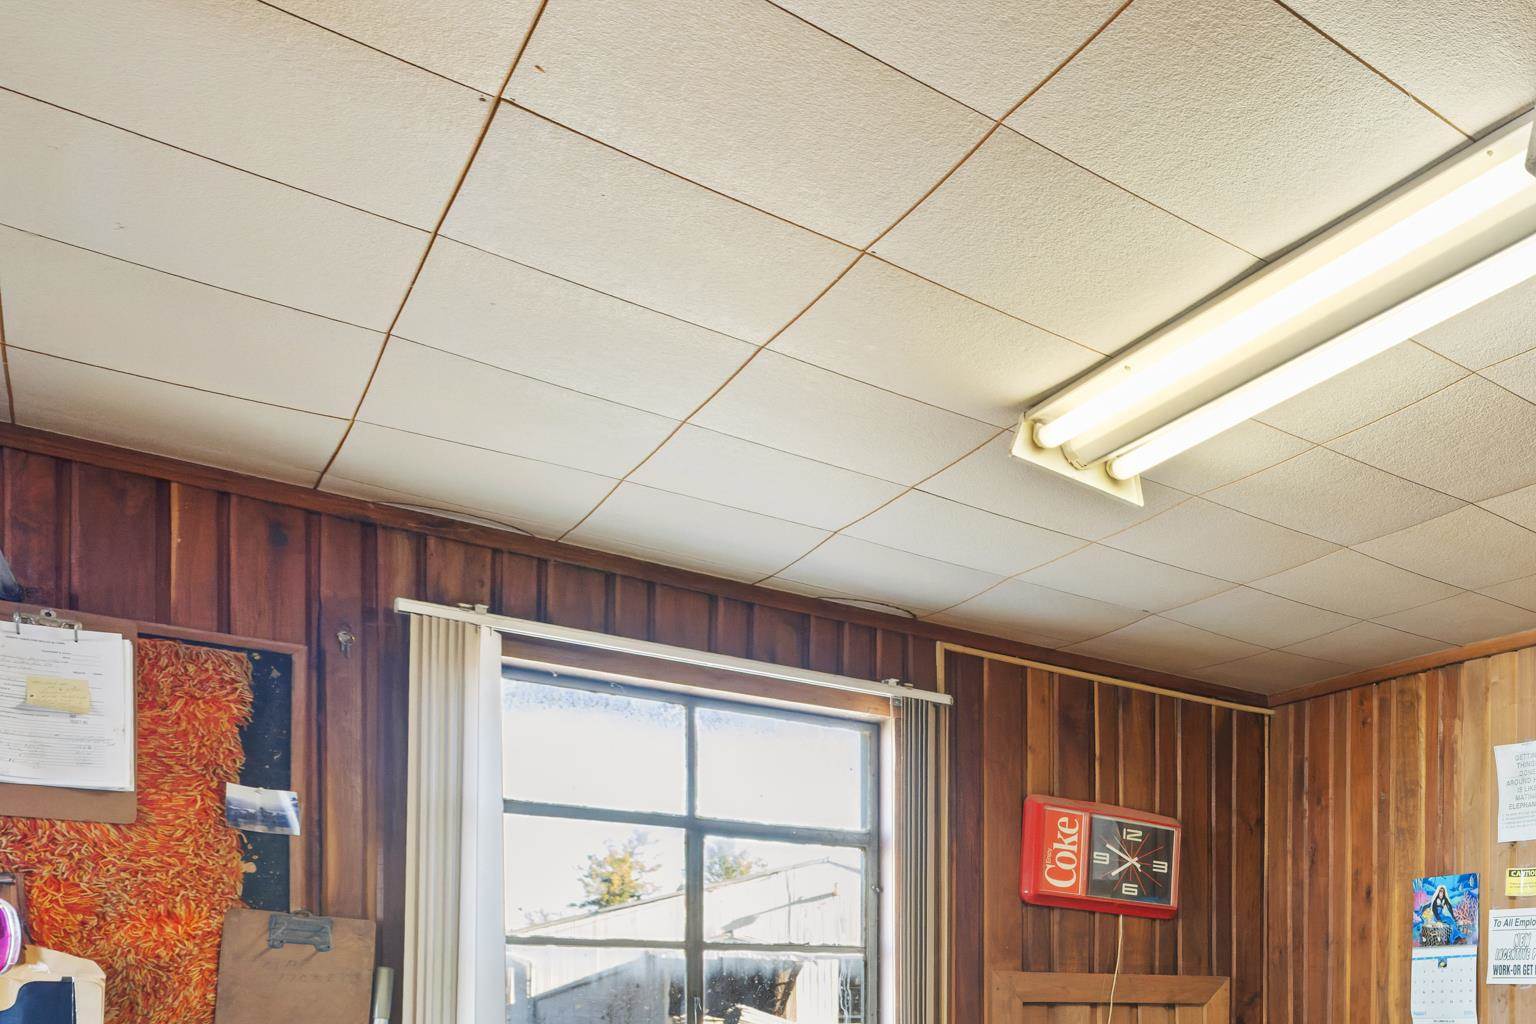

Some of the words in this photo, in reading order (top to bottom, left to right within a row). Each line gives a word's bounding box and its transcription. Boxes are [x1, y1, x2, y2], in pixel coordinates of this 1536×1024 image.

[1506, 778, 1531, 786] AROUND
[1122, 828, 1143, 842] 12
[1044, 816, 1079, 888] Coke
[1093, 852, 1110, 865] 9
[1152, 860, 1168, 873] 3
[1122, 883, 1138, 896] 6
[1493, 919, 1501, 928] To
[1503, 919, 1513, 927] All
[1523, 964, 1533, 976] GET
